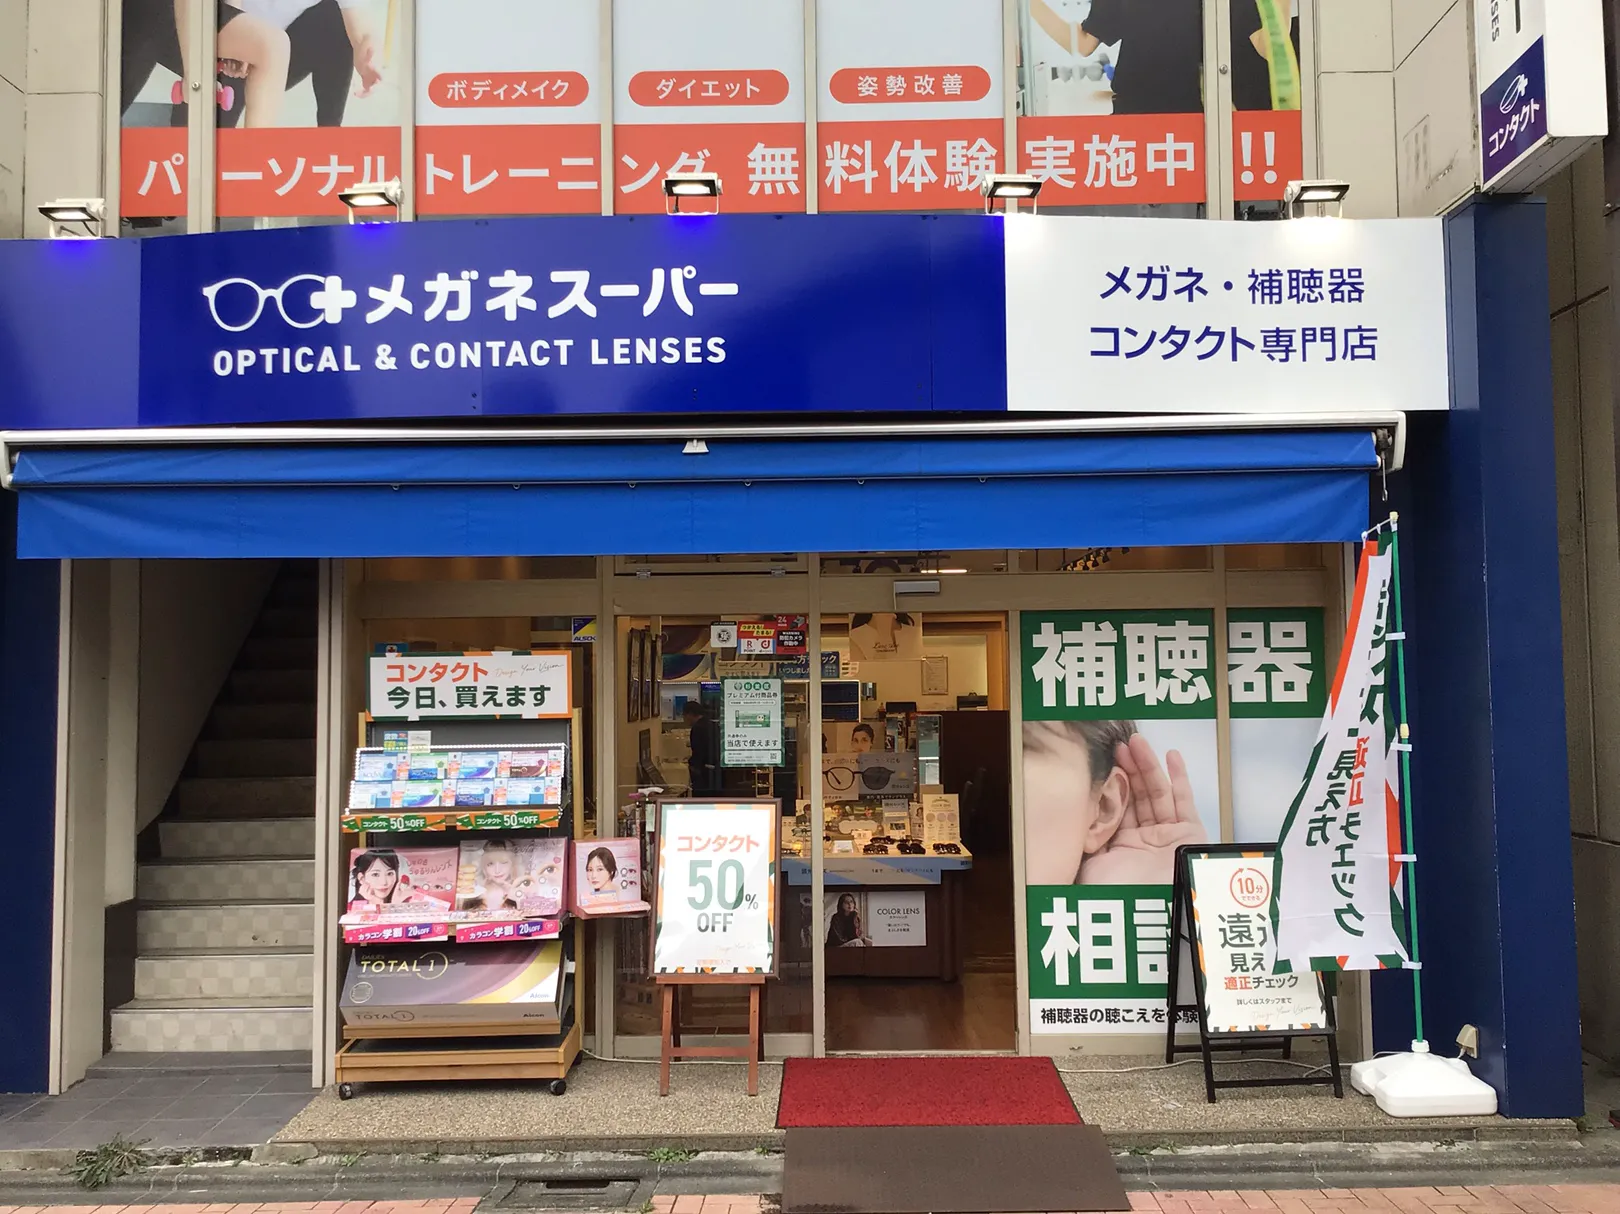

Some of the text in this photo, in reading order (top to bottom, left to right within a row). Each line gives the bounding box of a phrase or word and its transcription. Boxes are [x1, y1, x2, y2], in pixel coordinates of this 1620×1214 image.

[1490, 0, 1500, 42] SES
[446, 79, 570, 101] ボディメイク
[655, 77, 760, 99] ダイエット
[857, 73, 964, 97] 姿勢改善
[1489, 98, 1540, 157] コンタクト
[366, 265, 738, 324] メガネスーパー
[1099, 265, 1365, 305] メガネ・補聴器
[1090, 325, 1378, 363] コンタクト専門店
[213, 336, 726, 377] OPTICAL & CONTACT LENSES
[386, 662, 488, 683] コンタクト
[520, 664, 536, 676] Your
[538, 660, 565, 673] Vision
[1032, 619, 1314, 707] 補聴器
[386, 685, 551, 710] 今日、買えます
[727, 740, 778, 748] 当店で使えます
[362, 820, 387, 828] コンタクト
[476, 817, 501, 825] コンタクト
[677, 834, 760, 853] コンタクト
[877, 907, 920, 915] COLOR LENS
[469, 924, 514, 940] カラコン学割
[697, 912, 734, 933] OFF
[358, 927, 403, 941] カラコン学割
[360, 960, 421, 973] TOTAL
[1224, 975, 1299, 991] 適正チェック
[1236, 997, 1292, 1006] 詳しくはスタッフまで
[1041, 1007, 1198, 1024] 補聴器の聴こえを験
